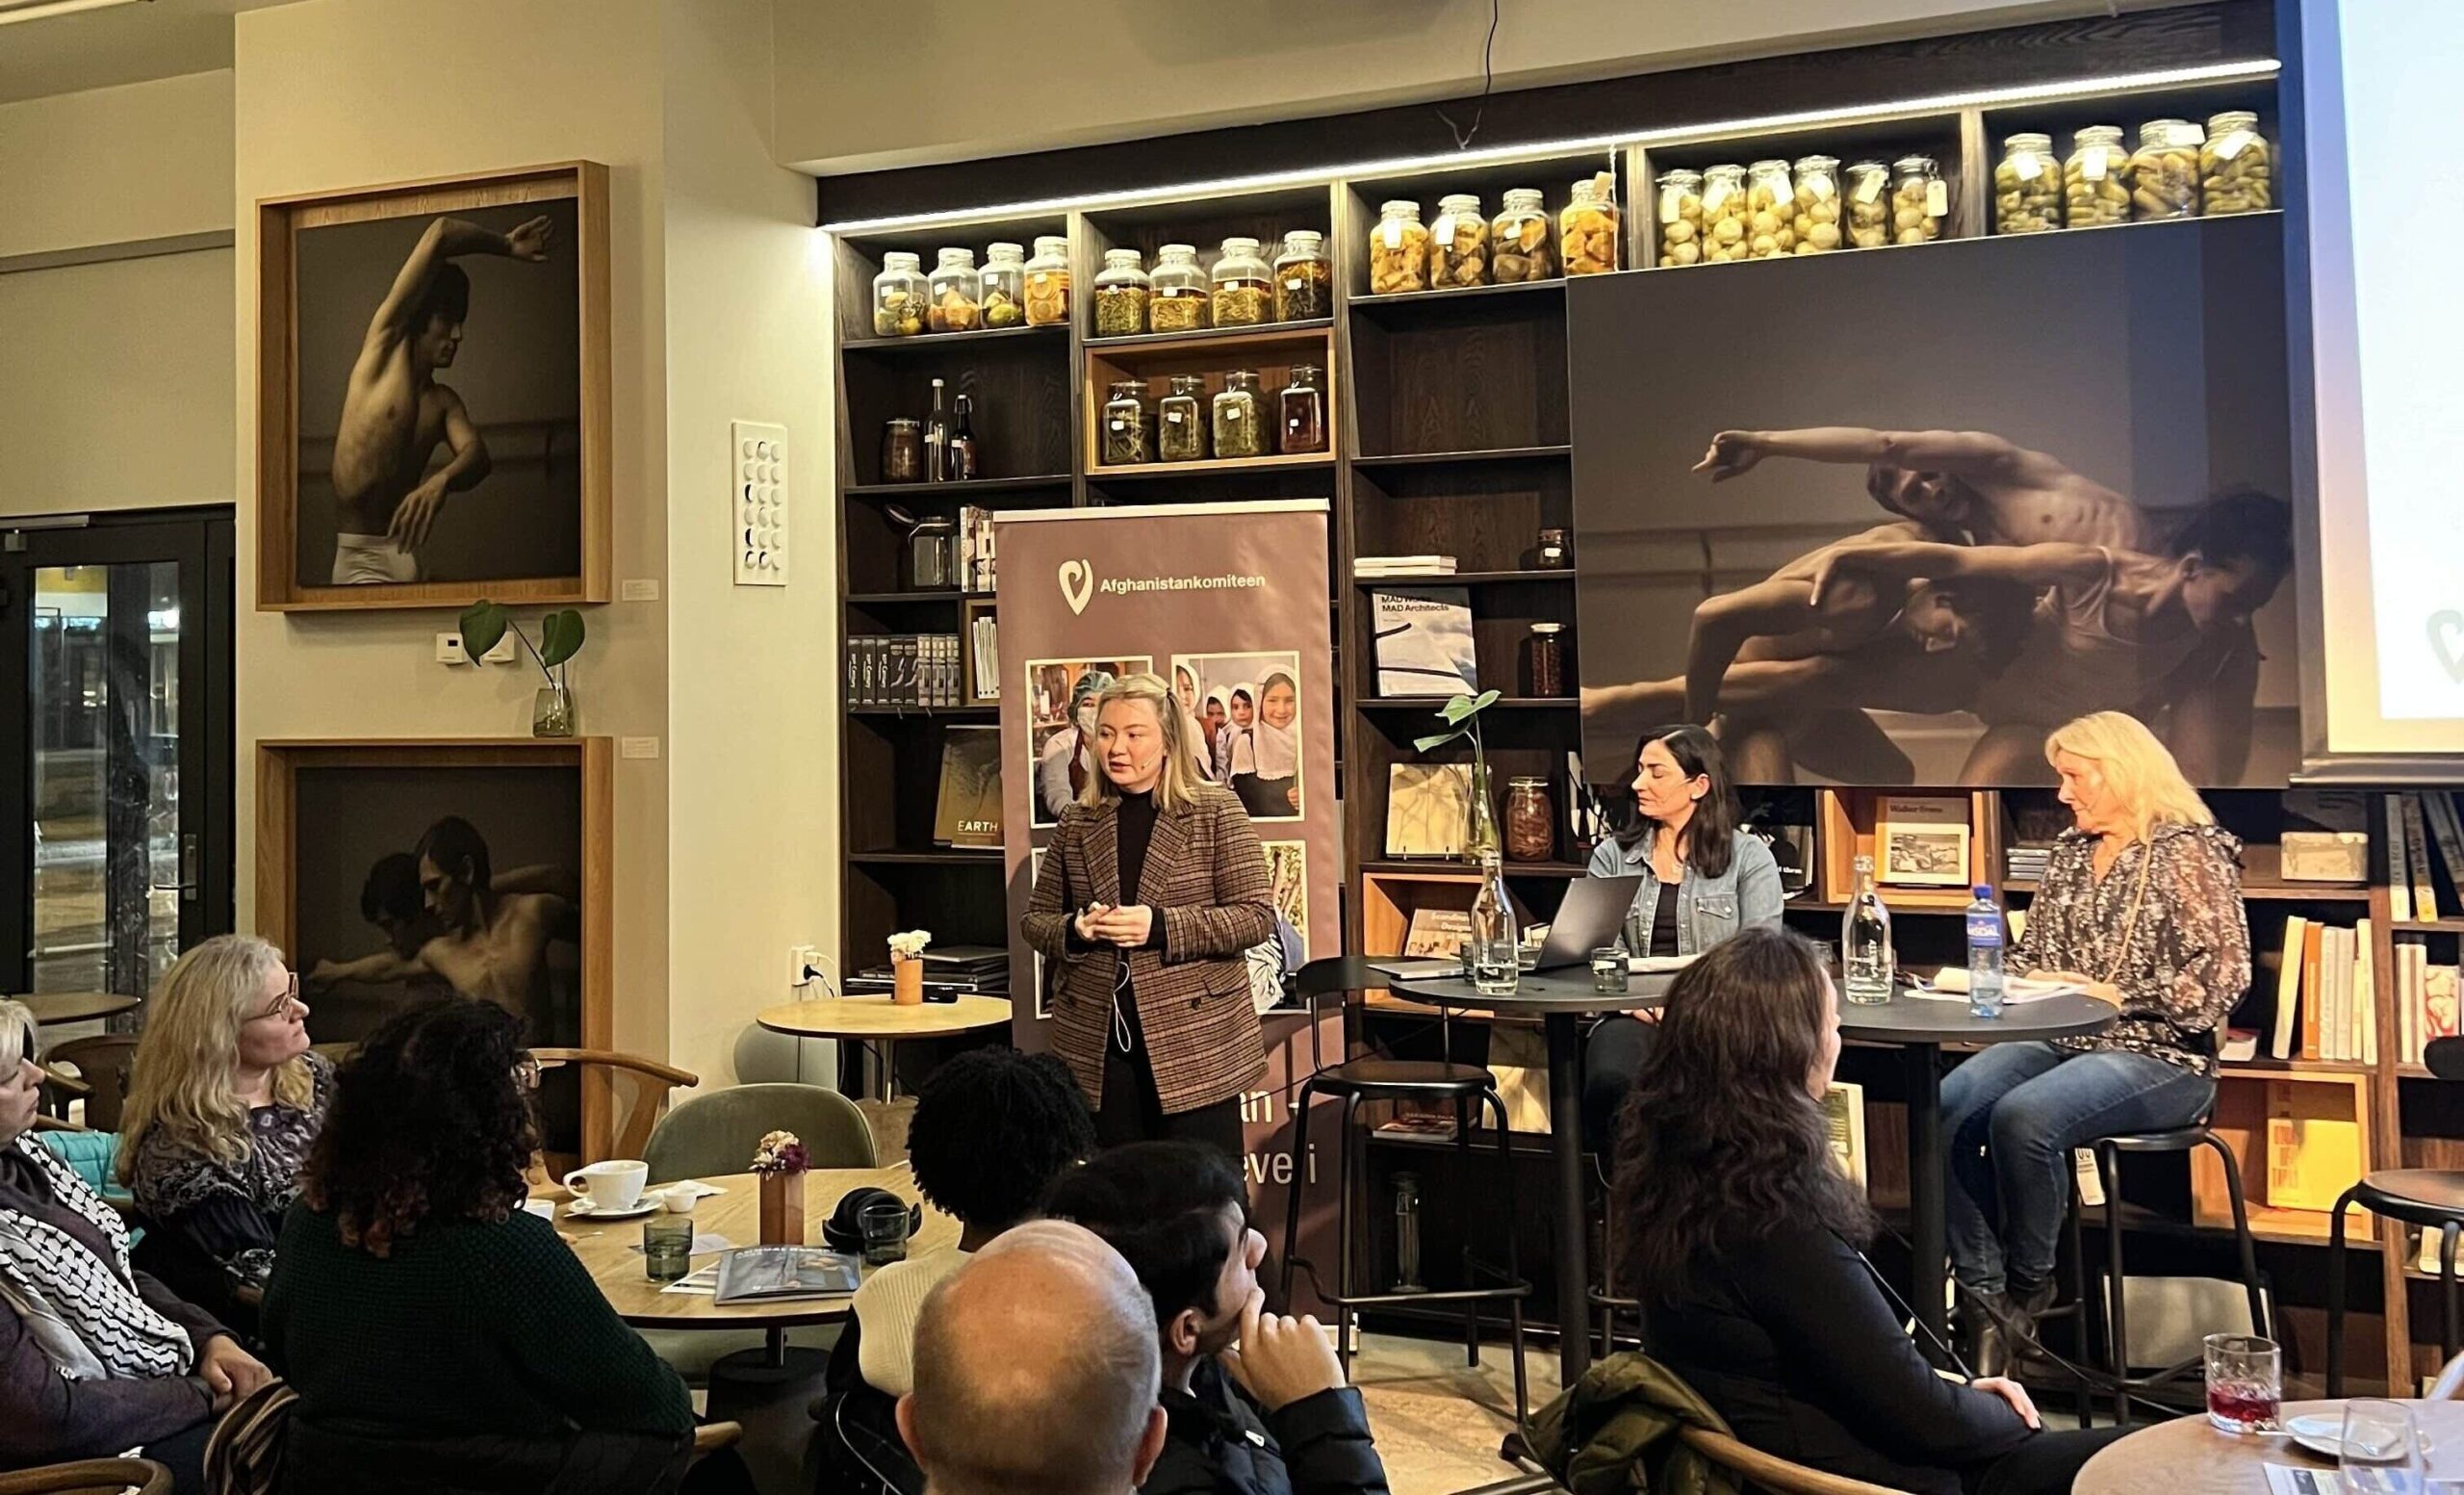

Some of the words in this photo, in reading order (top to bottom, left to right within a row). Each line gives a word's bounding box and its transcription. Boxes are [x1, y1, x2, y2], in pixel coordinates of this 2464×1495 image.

[1099, 574, 1267, 595] Afghanistankomiteen
[1381, 595, 1403, 604] MAD
[1405, 604, 1450, 612] Architects
[957, 819, 999, 833] EARTH
[1308, 1143, 1317, 1184] i
